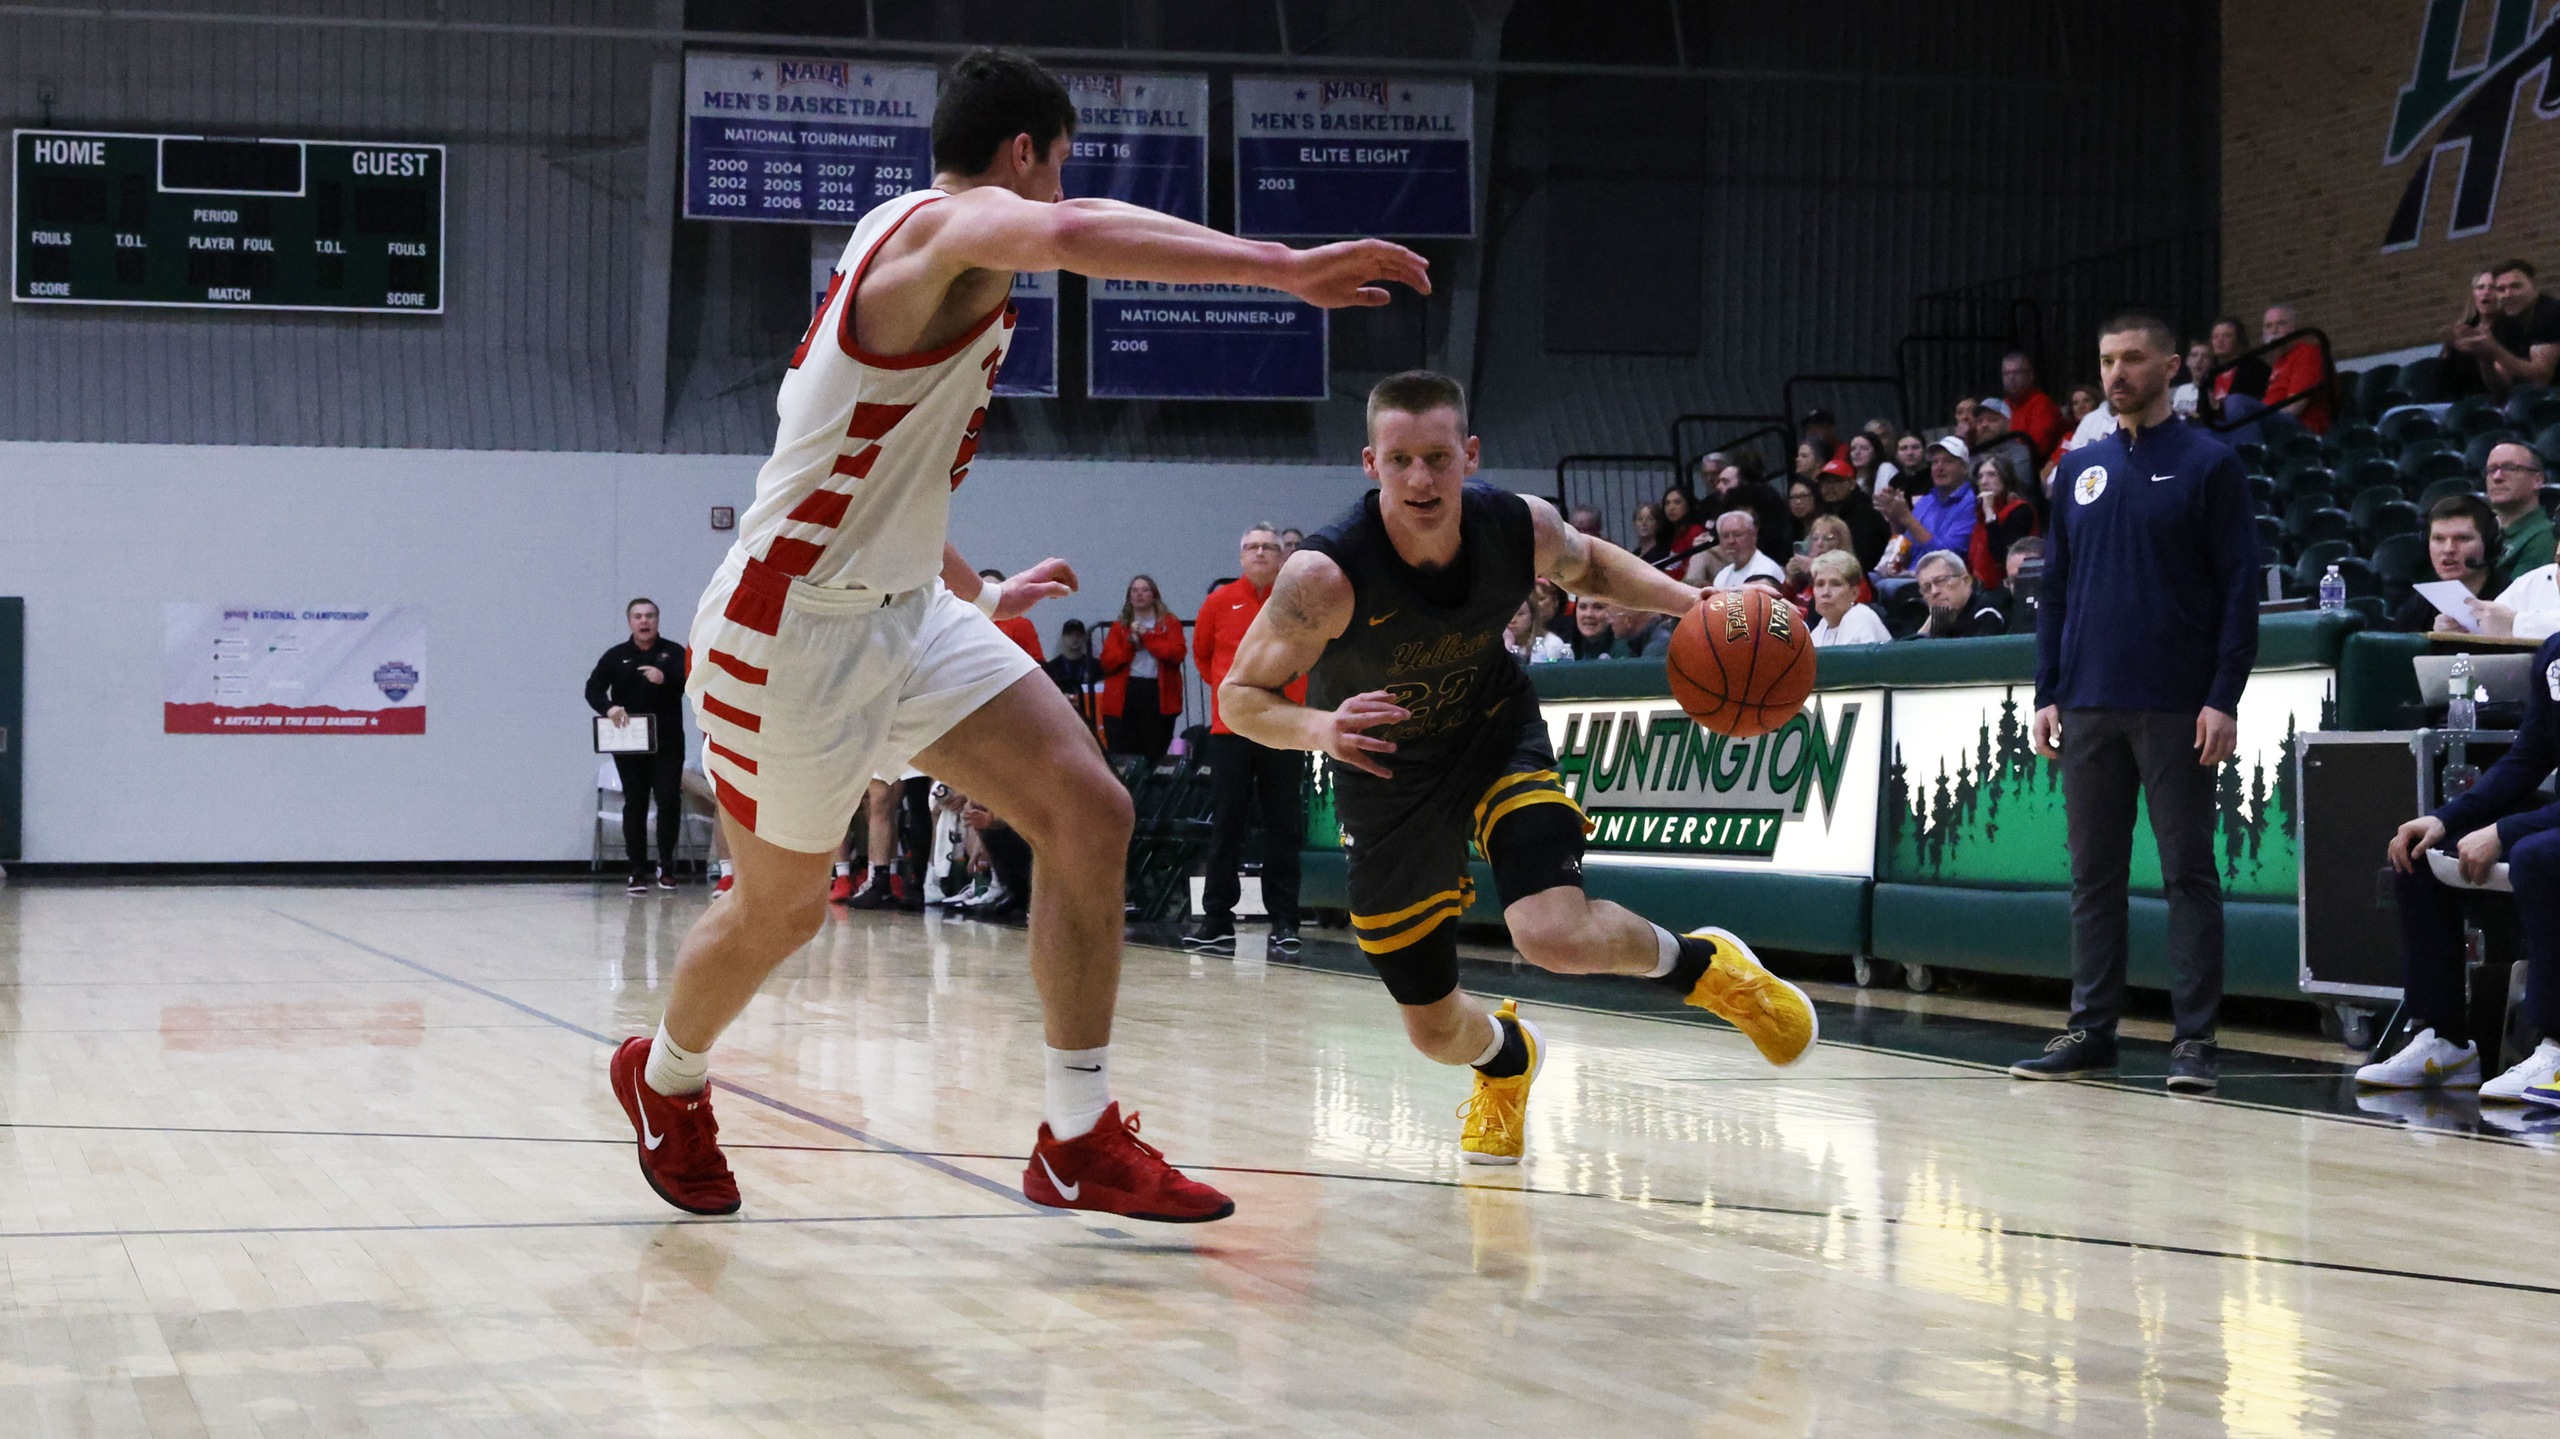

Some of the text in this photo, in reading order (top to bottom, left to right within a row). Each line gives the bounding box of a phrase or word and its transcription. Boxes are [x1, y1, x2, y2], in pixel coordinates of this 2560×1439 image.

[779, 61, 847, 91] NAIA
[1321, 80, 1387, 105] NAIA
[703, 91, 918, 119] MEN'S BASKETBALL
[1081, 107, 1189, 127] SKETBALL
[1250, 112, 1455, 132] MEN'S BASKETBALL
[724, 127, 897, 149] NATIONAL TOURNAMENT
[34, 139, 106, 166] HOME
[1072, 142, 1131, 158] EET 16
[1300, 147, 1411, 164] ELITE EIGHT
[352, 151, 429, 177] GUEST
[708, 158, 913, 181] 2000 2004 2007 2023
[708, 175, 747, 190] 2002
[763, 178, 802, 192] 2005
[818, 181, 854, 195] 2014
[1258, 177, 1296, 192] 2003
[708, 193, 855, 213] 2003 2006 2022
[193, 208, 239, 224] PERIOD
[31, 230, 72, 246] FOULS
[188, 236, 275, 252] PLAYER FOUL
[315, 240, 347, 254] T.O.L.
[388, 242, 427, 257] FOULS
[30, 281, 71, 297] SCORE
[208, 287, 251, 302] MATCH
[386, 292, 426, 307] SCORE
[1120, 309, 1296, 325] NATIONAL RUNNER-UP
[1110, 339, 1149, 353] 2006
[252, 610, 297, 621] NATIONAL
[301, 610, 370, 621] CHAMPIONSHIP
[1557, 703, 1858, 822] HUNTINGTON
[1585, 814, 1775, 848] UNIVERSITY
